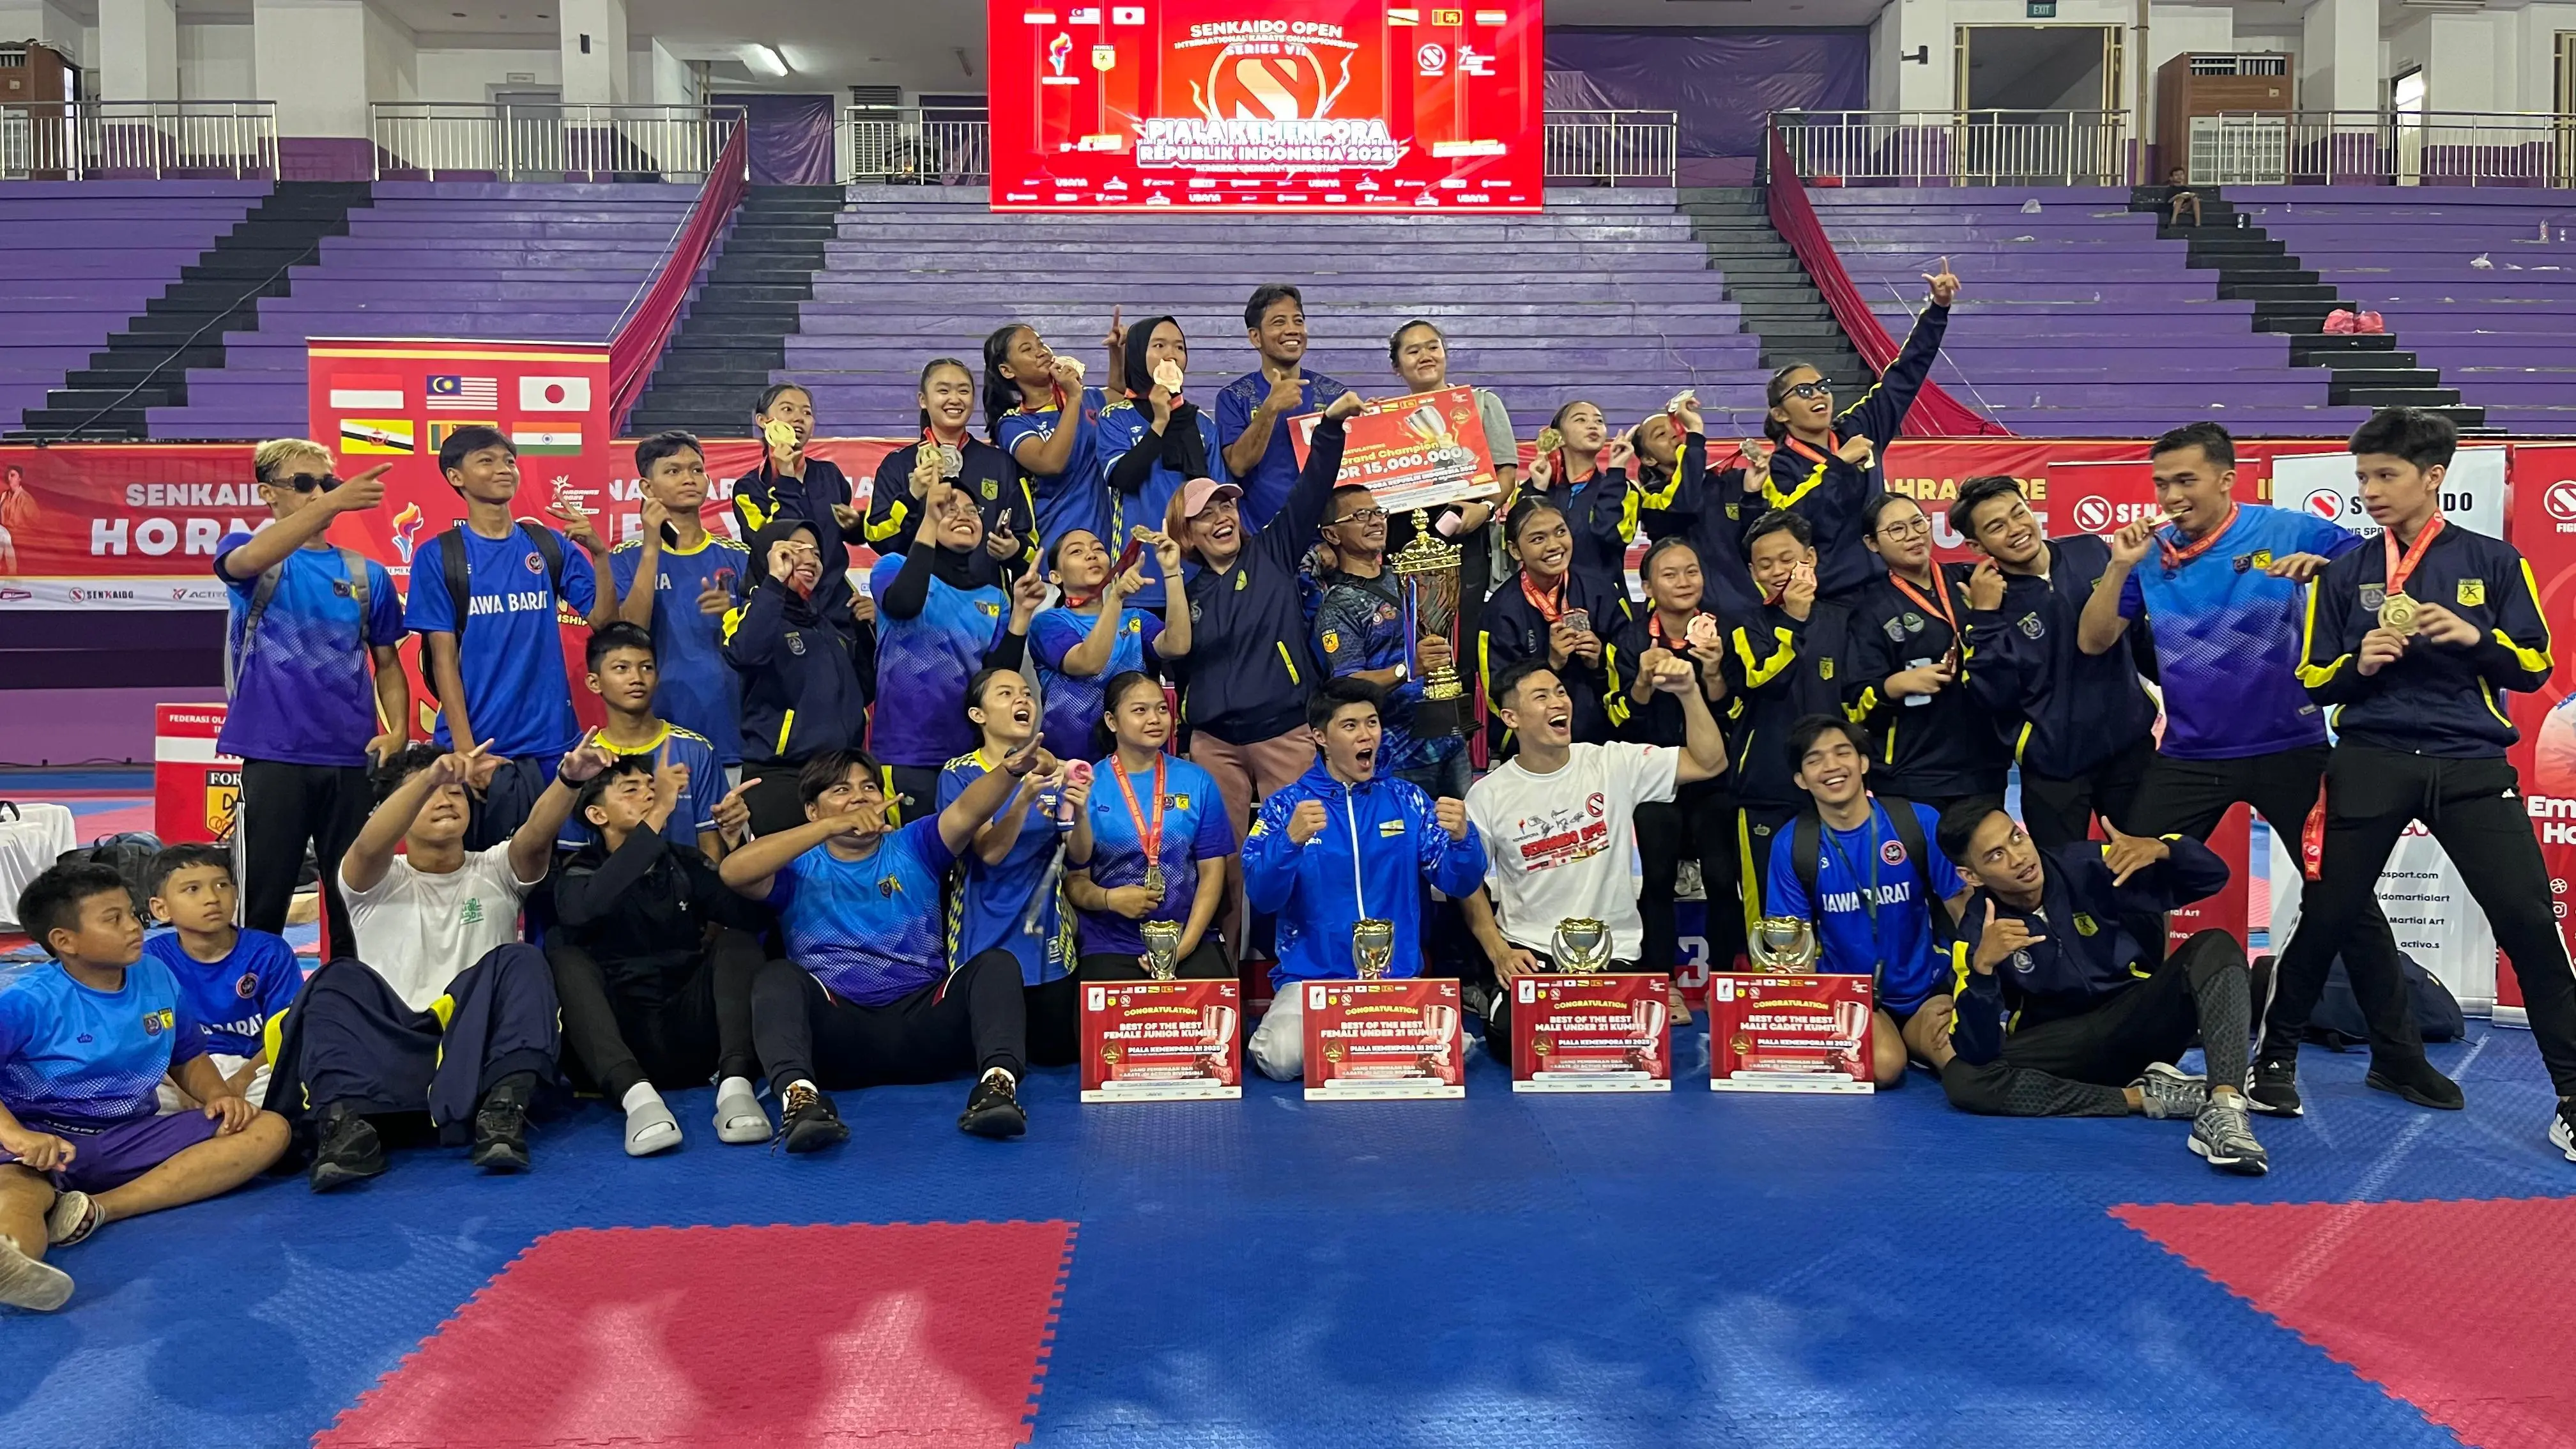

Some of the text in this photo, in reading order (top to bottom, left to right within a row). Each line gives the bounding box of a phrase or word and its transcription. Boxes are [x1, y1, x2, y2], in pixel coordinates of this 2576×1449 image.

[2034, 5, 2050, 15] EXIT
[1190, 20, 1342, 38] SENKAIDO OPEN
[1174, 34, 1359, 50] INTERNATIONAL KARATE CHAMPIONSHIP
[1225, 43, 1307, 56] SERIES VII
[1147, 119, 1228, 142] PIALA
[1228, 119, 1390, 142] KEMENPORA
[1139, 144, 1396, 162] REPUBLIK INDONESIA 2025
[1340, 441, 1440, 466] Grand Champion
[126, 483, 267, 507] SENKAID
[87, 590, 134, 599] SENKAIDO
[469, 590, 548, 617] AWA BARAT
[169, 714, 210, 723] FEDERASI
[210, 772, 241, 785] FOR
[1521, 830, 1580, 857] SENKAIDO
[2380, 871, 2439, 879] osport.com
[2389, 917, 2426, 925] Martial
[1553, 999, 1628, 1009] CONGRATULATION
[1752, 999, 1829, 1010] CONGRATULATION
[1123, 1006, 1199, 1017] CONGRATULATION
[1345, 1005, 1419, 1015] CONGRATULATION
[1549, 1016, 1574, 1024] BEST
[1589, 1015, 1607, 1023] THE
[1608, 1015, 1632, 1023] BEST
[1748, 1015, 1834, 1024] BEST OF THE BEST
[1119, 1023, 1142, 1031] BEST
[1179, 1022, 1202, 1030] BEST
[1340, 1022, 1365, 1030] BEST
[1381, 1021, 1399, 1029] THE
[1400, 1020, 1423, 1029] BEST
[1535, 1022, 1647, 1031] MALE UNDER 21 KUMITE
[1740, 1022, 1842, 1032] MALE CADET KUMITE
[1103, 1029, 1218, 1039] FEMALE JUNIOR KUMITE
[1321, 1030, 1359, 1038] FEMALE
[1360, 1029, 1394, 1038] UNDER
[1407, 1028, 1444, 1037] KUMITE
